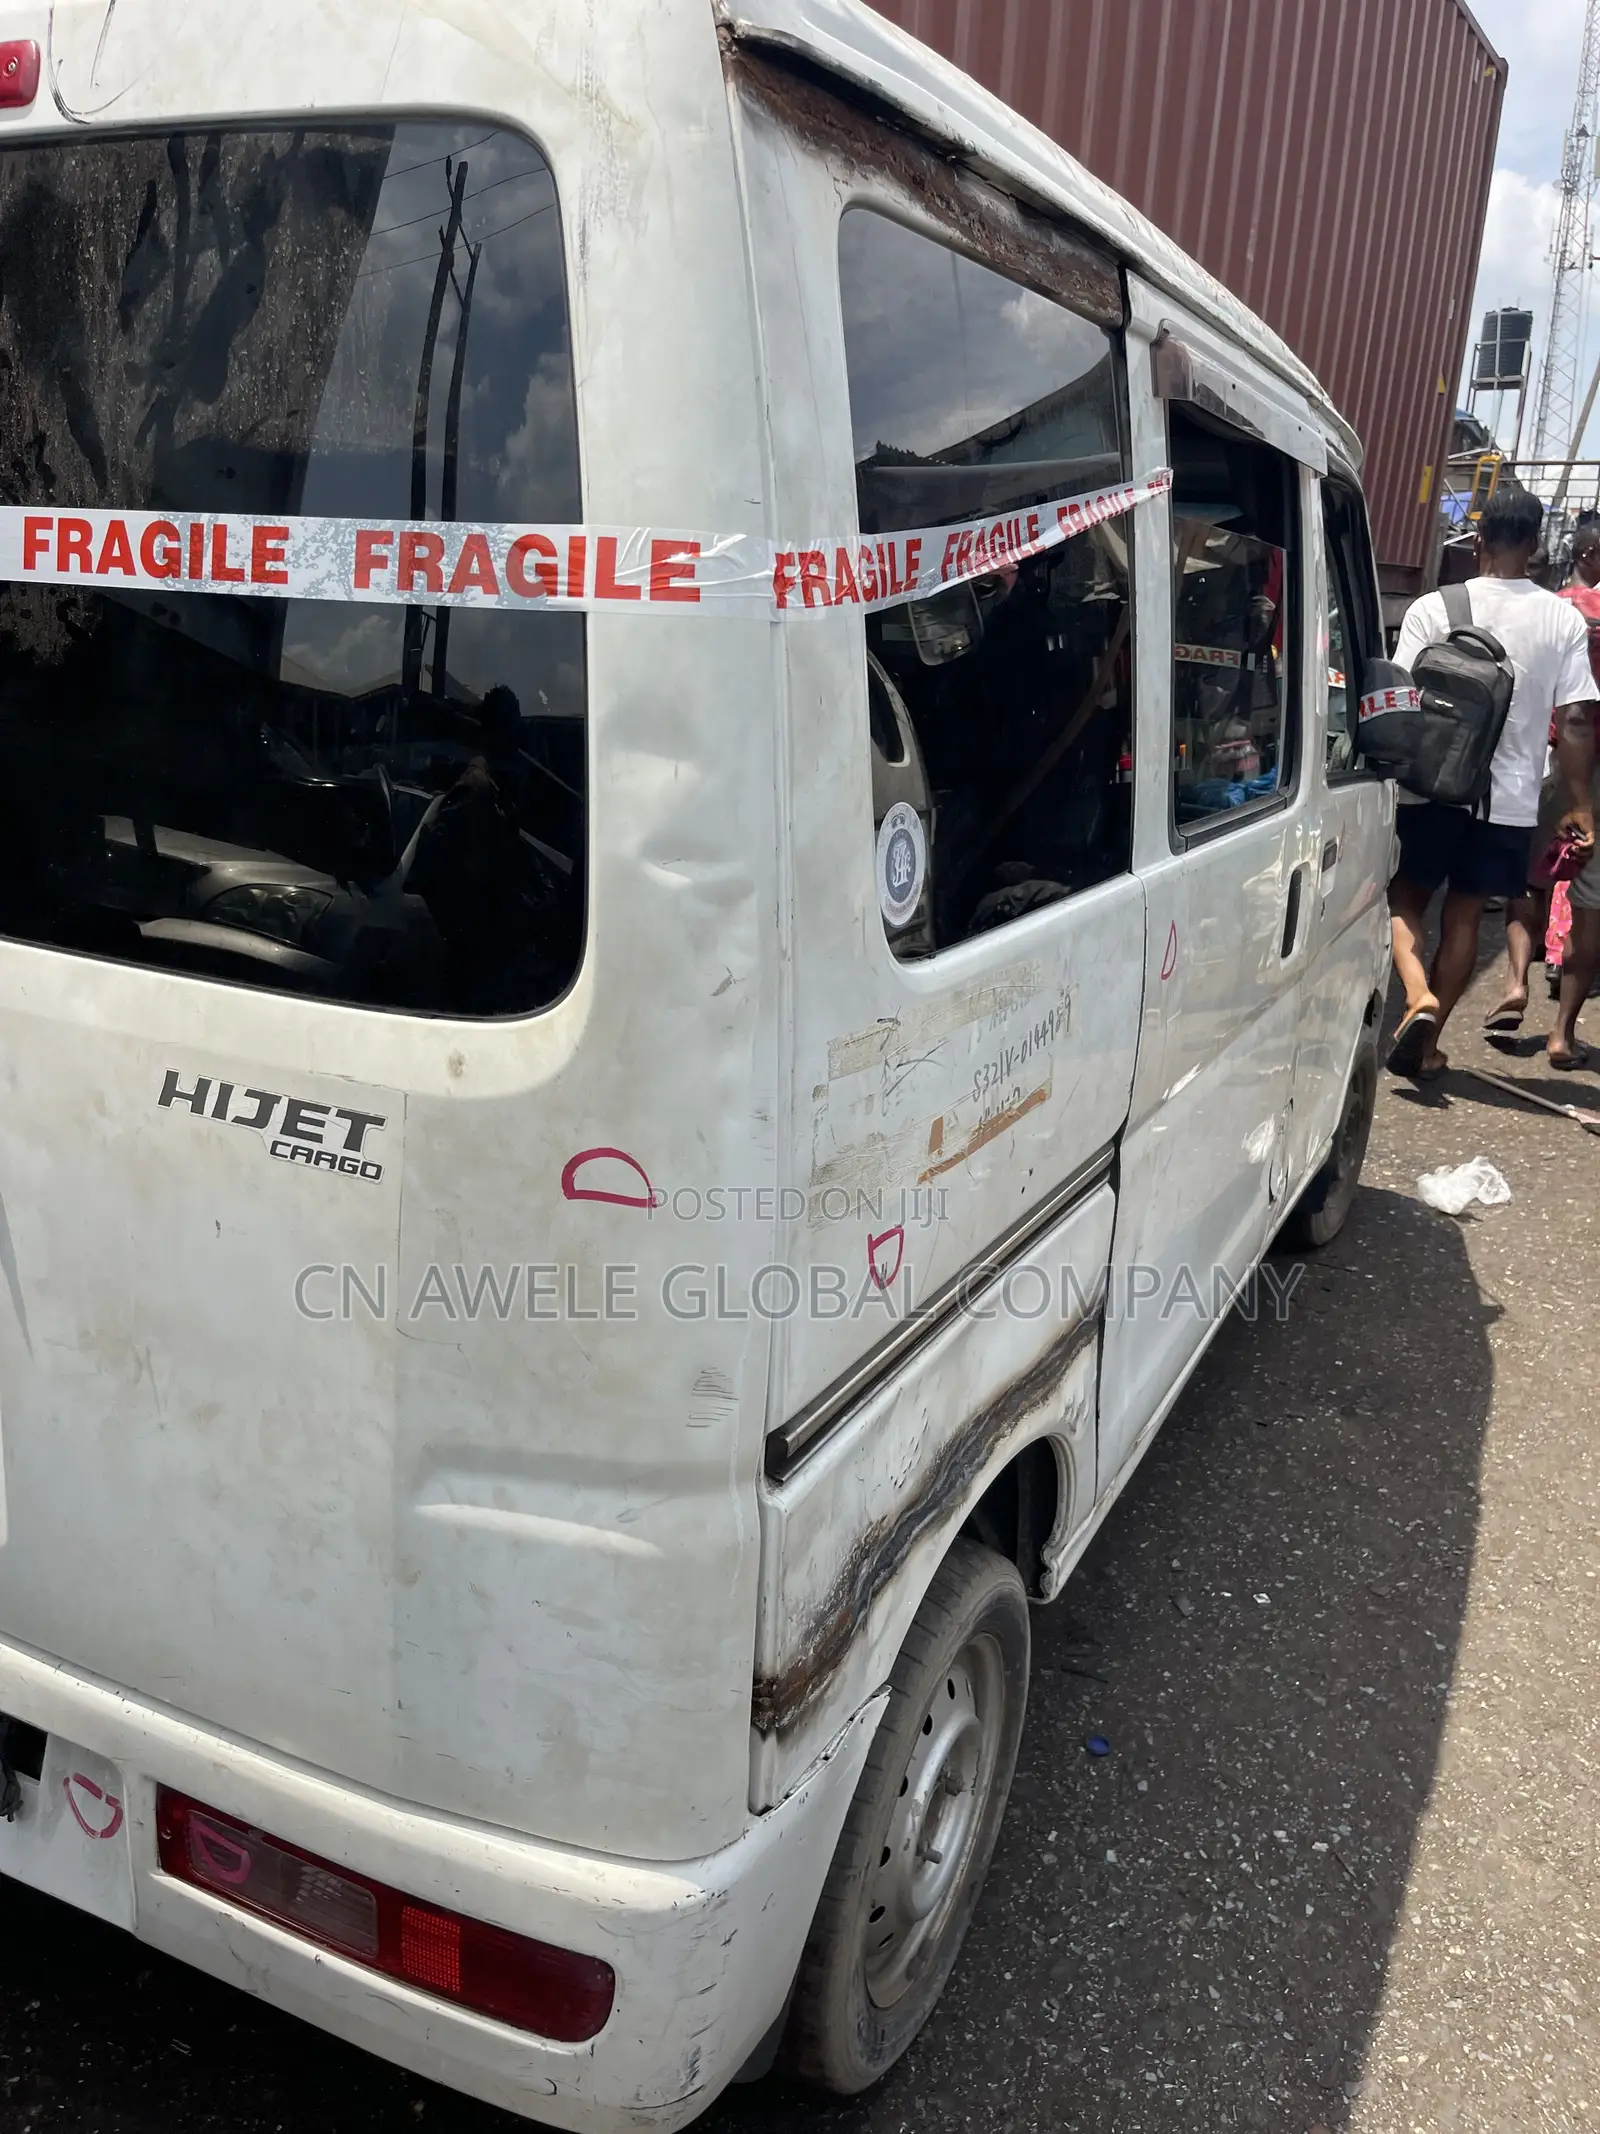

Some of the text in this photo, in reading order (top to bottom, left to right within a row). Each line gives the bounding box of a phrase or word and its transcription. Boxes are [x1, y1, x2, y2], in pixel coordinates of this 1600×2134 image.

[23, 515, 290, 585] FRAGILE
[353, 529, 701, 603] FRAGILE
[772, 538, 922, 610] FRAGILE
[940, 513, 1047, 583] FRAGILE
[157, 1069, 387, 1153] HIJET
[269, 1140, 384, 1181] CARGO
